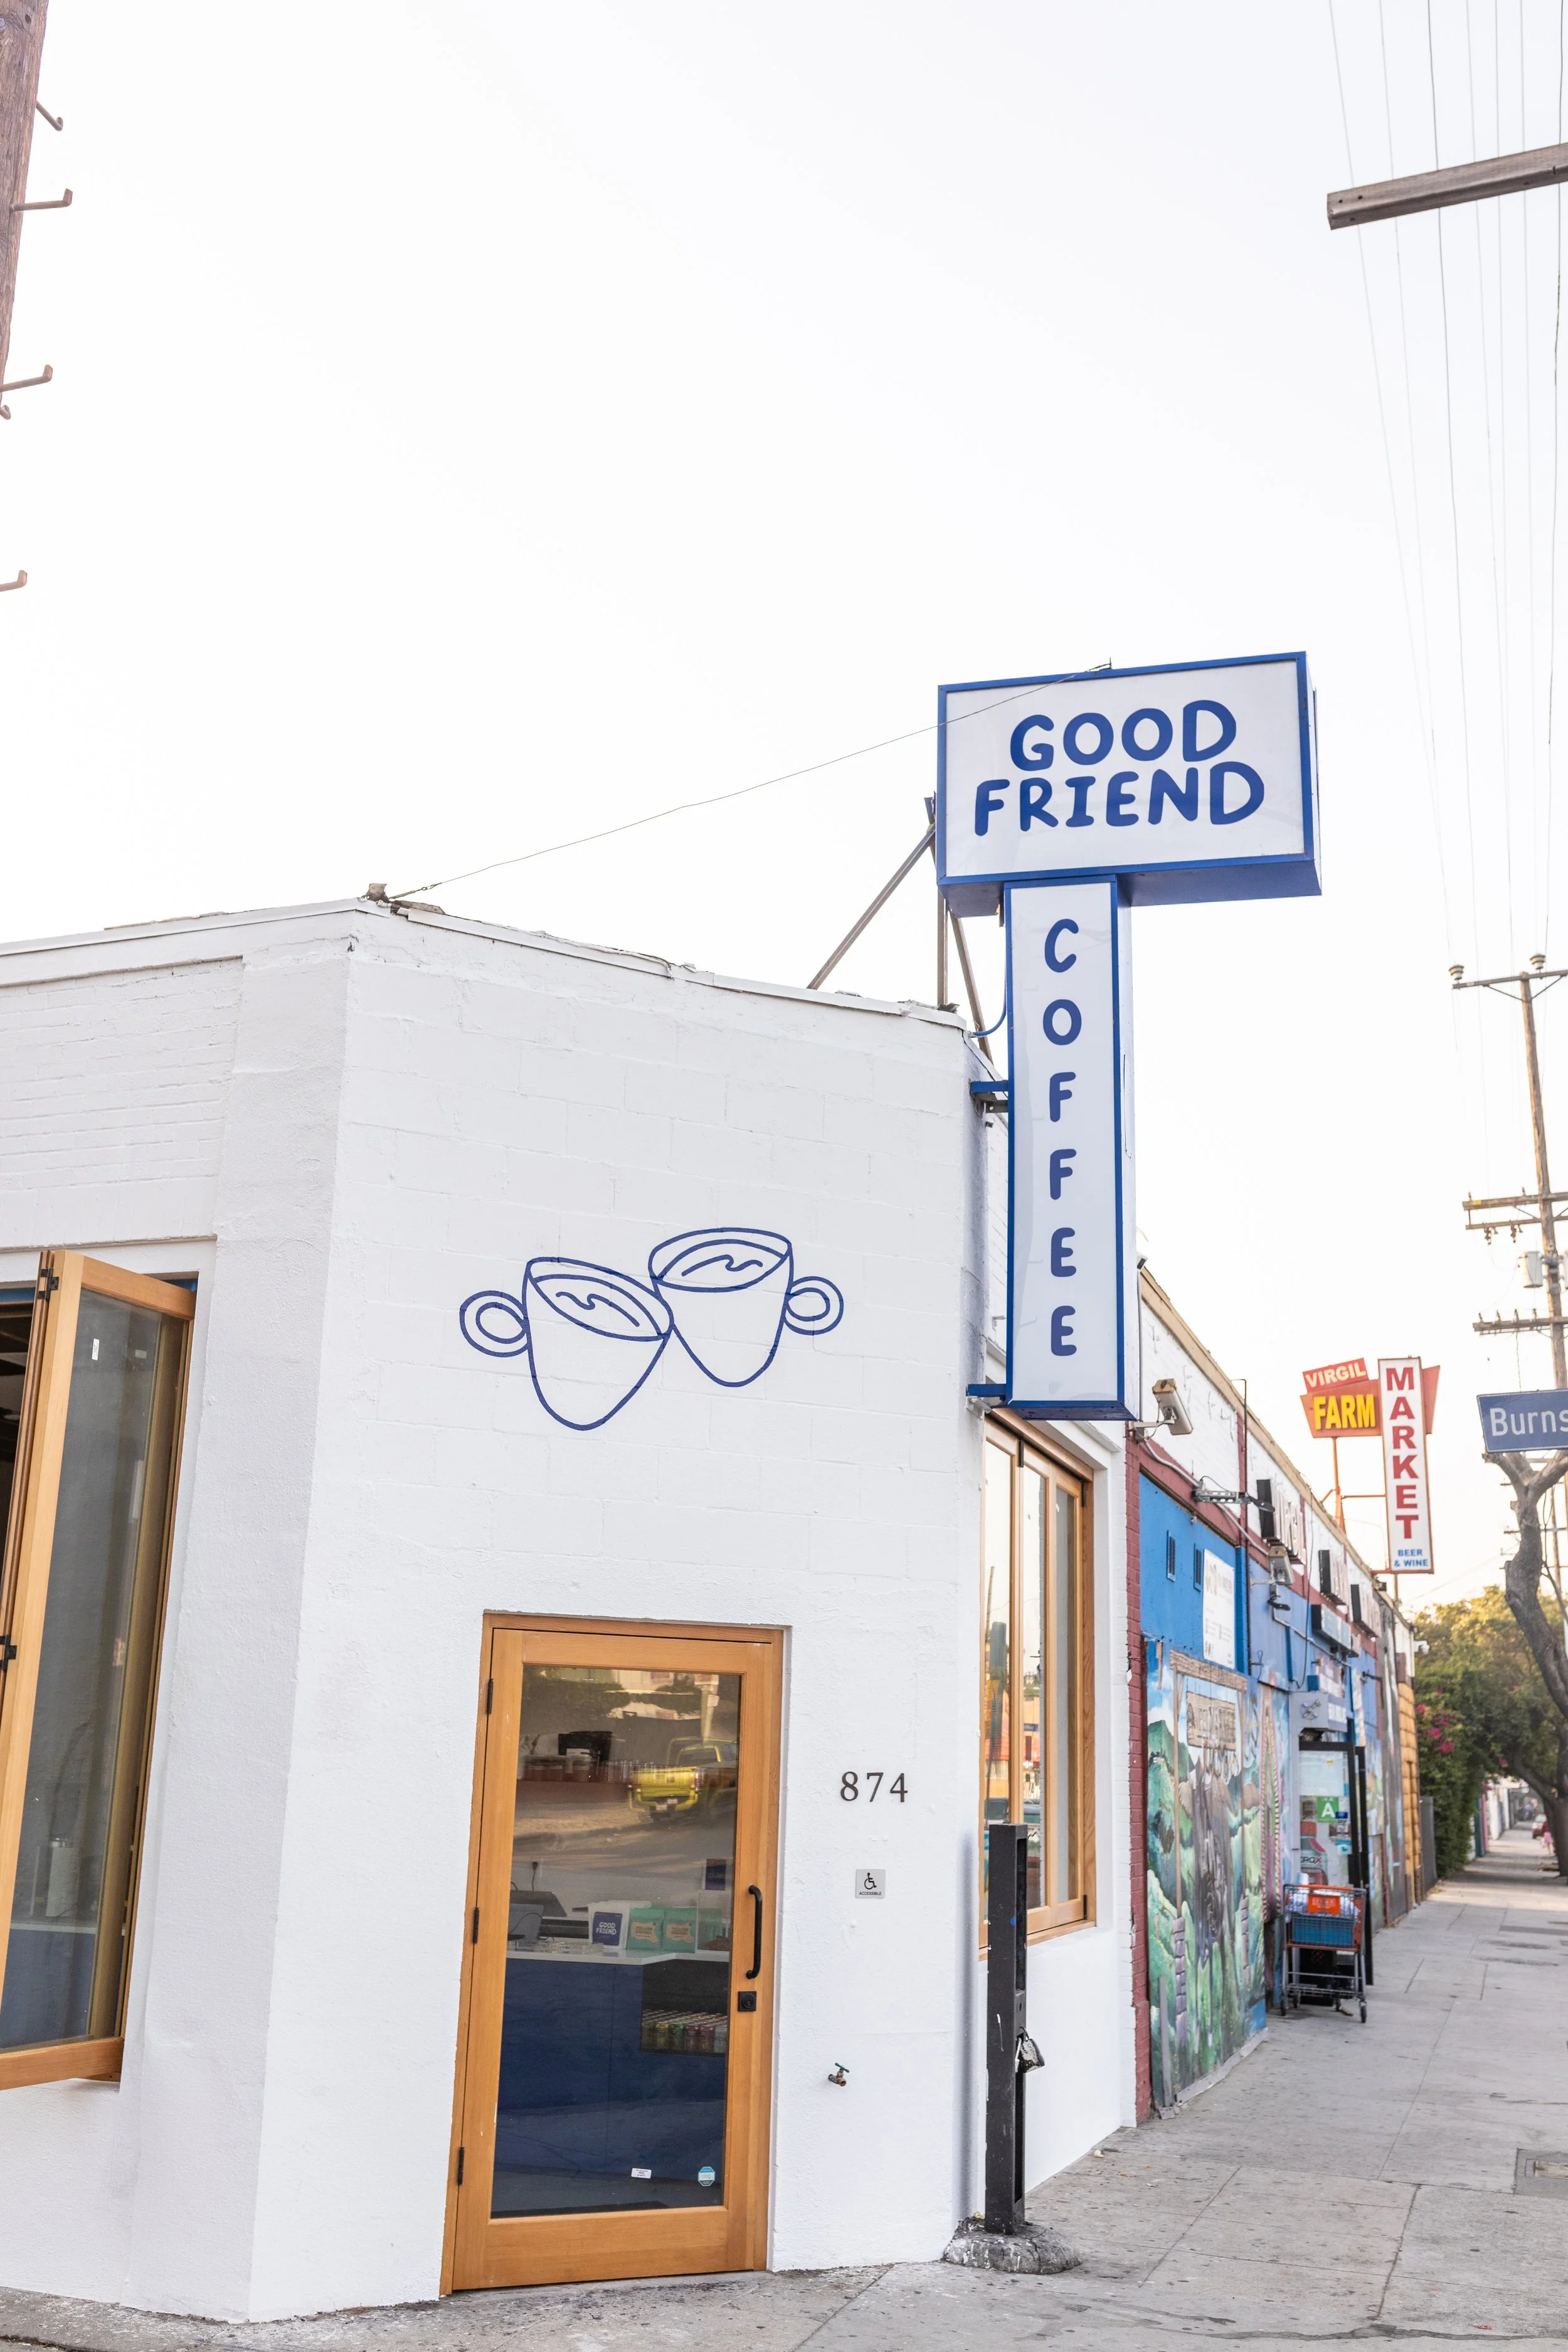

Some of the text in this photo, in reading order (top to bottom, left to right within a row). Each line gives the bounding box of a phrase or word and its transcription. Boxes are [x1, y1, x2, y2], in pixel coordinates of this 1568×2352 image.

[1010, 699, 1237, 771] GOOD
[974, 761, 1265, 837] FRIEND
[1042, 918, 1082, 1355] COFFEE
[1305, 1362, 1367, 1389] VIRGIL
[1313, 1394, 1375, 1430] FARM
[1490, 1407, 1568, 1437] Burns
[1386, 1366, 1418, 1539] MARKET
[1394, 1559, 1428, 1567] & WINE
[1397, 1548, 1423, 1557] BEER
[840, 1771, 908, 1803] 874
[1322, 1802, 1335, 1818] A
[596, 1927, 617, 1936] FRIEND
